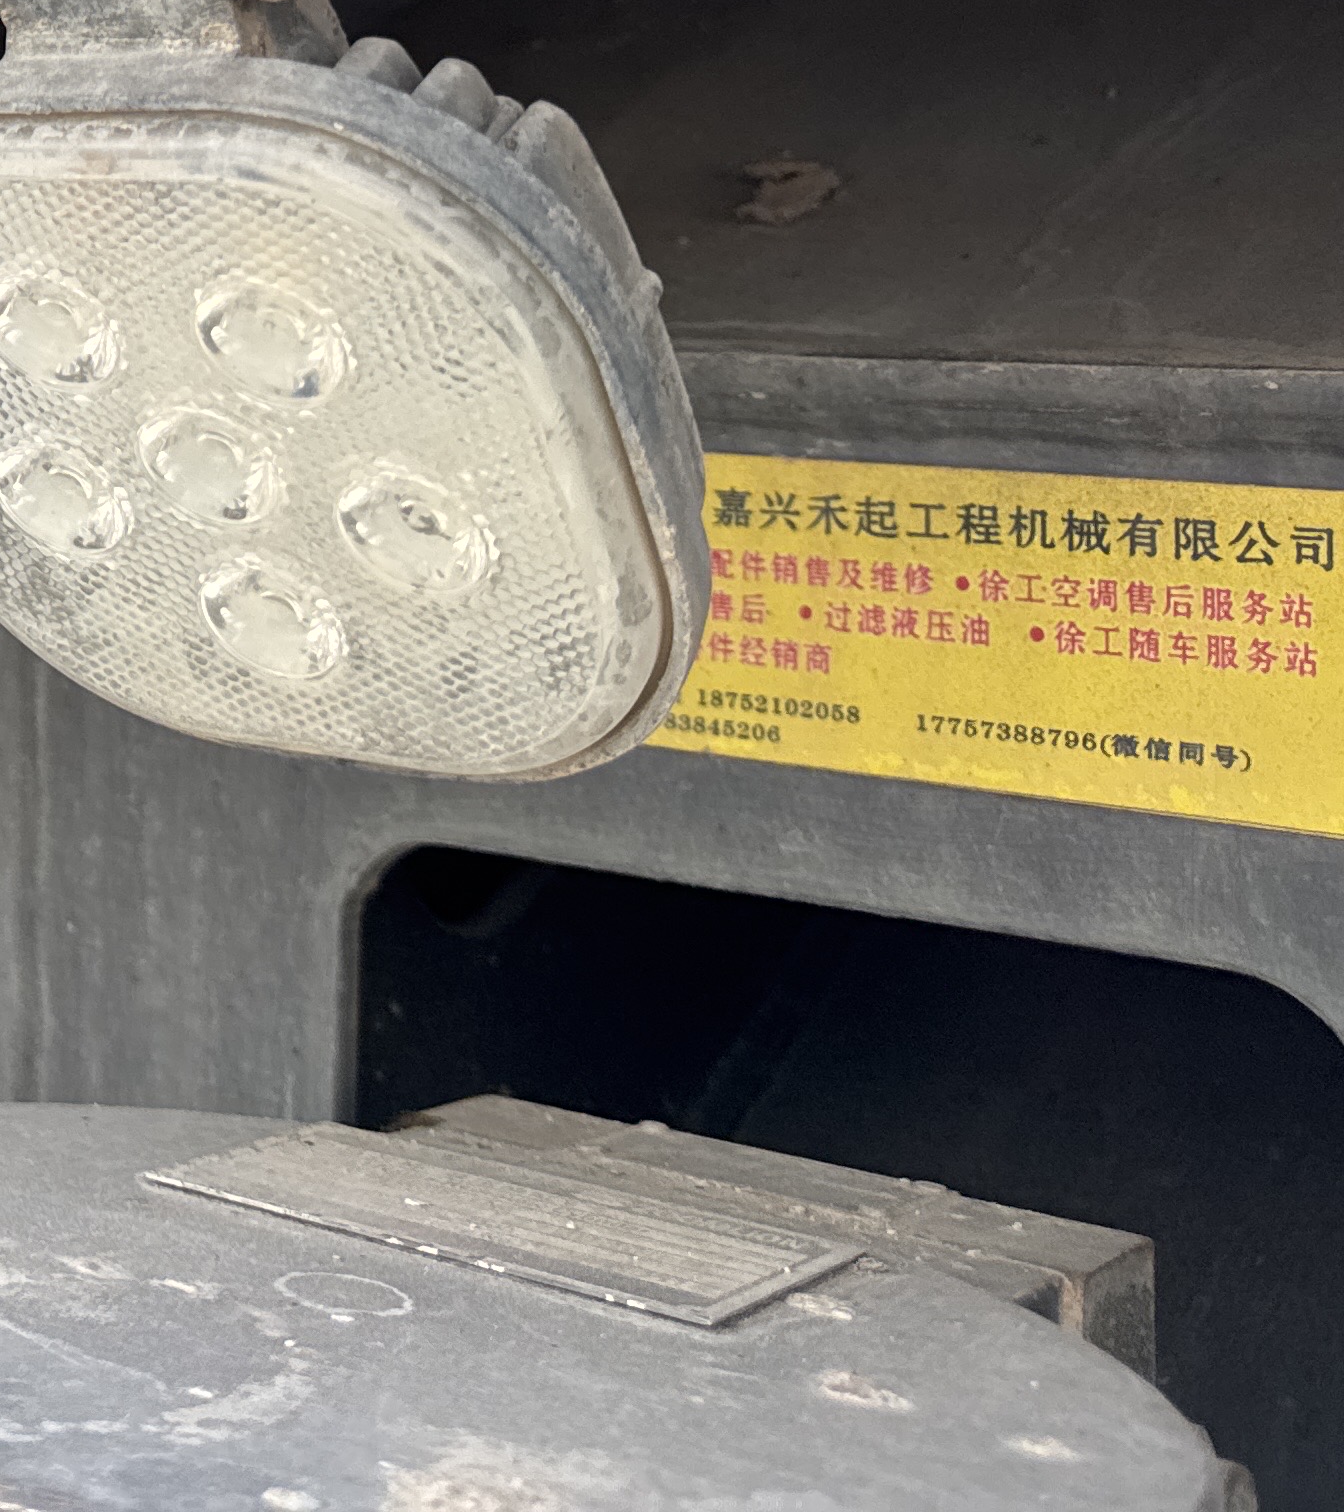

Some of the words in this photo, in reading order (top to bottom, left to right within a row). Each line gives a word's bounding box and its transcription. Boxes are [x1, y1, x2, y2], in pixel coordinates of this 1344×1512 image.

[713, 489, 1335, 571] 嘉兴禾起工程机械有限公司
[978, 569, 1313, 629] 徐工空调售后服务站
[697, 632, 833, 674] 件经销商
[824, 601, 991, 647] 过滤液压油
[1054, 620, 1318, 678] 徐工随车服务站
[697, 689, 861, 724] 18752102058
